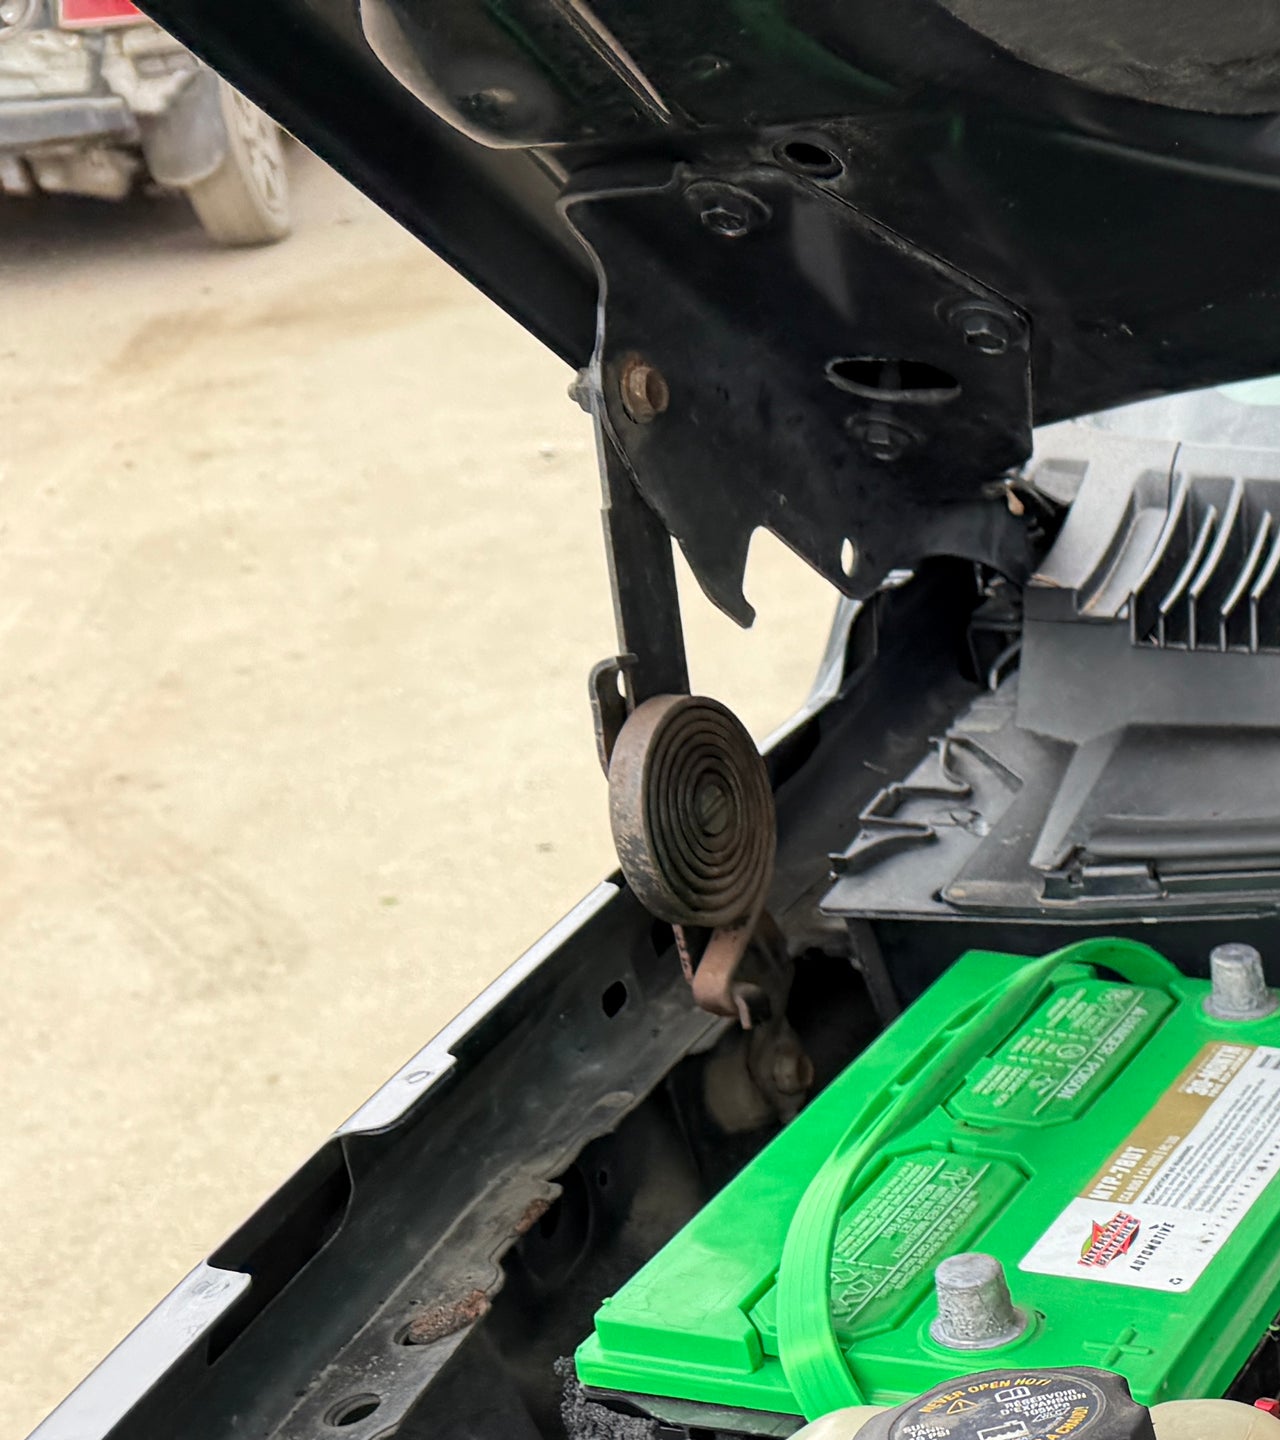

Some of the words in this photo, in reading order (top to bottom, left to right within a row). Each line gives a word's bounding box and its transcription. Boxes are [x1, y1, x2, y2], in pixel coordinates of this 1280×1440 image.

[1080, 1213, 1130, 1266] INTERSTATE
[1096, 1217, 1139, 1266] BATTERIES
[1129, 1221, 1175, 1272] AUTOMOTIVE
[918, 1390, 966, 1414] NEVER
[968, 1379, 1011, 1393] OPEN
[1014, 1377, 1052, 1387] HOT!
